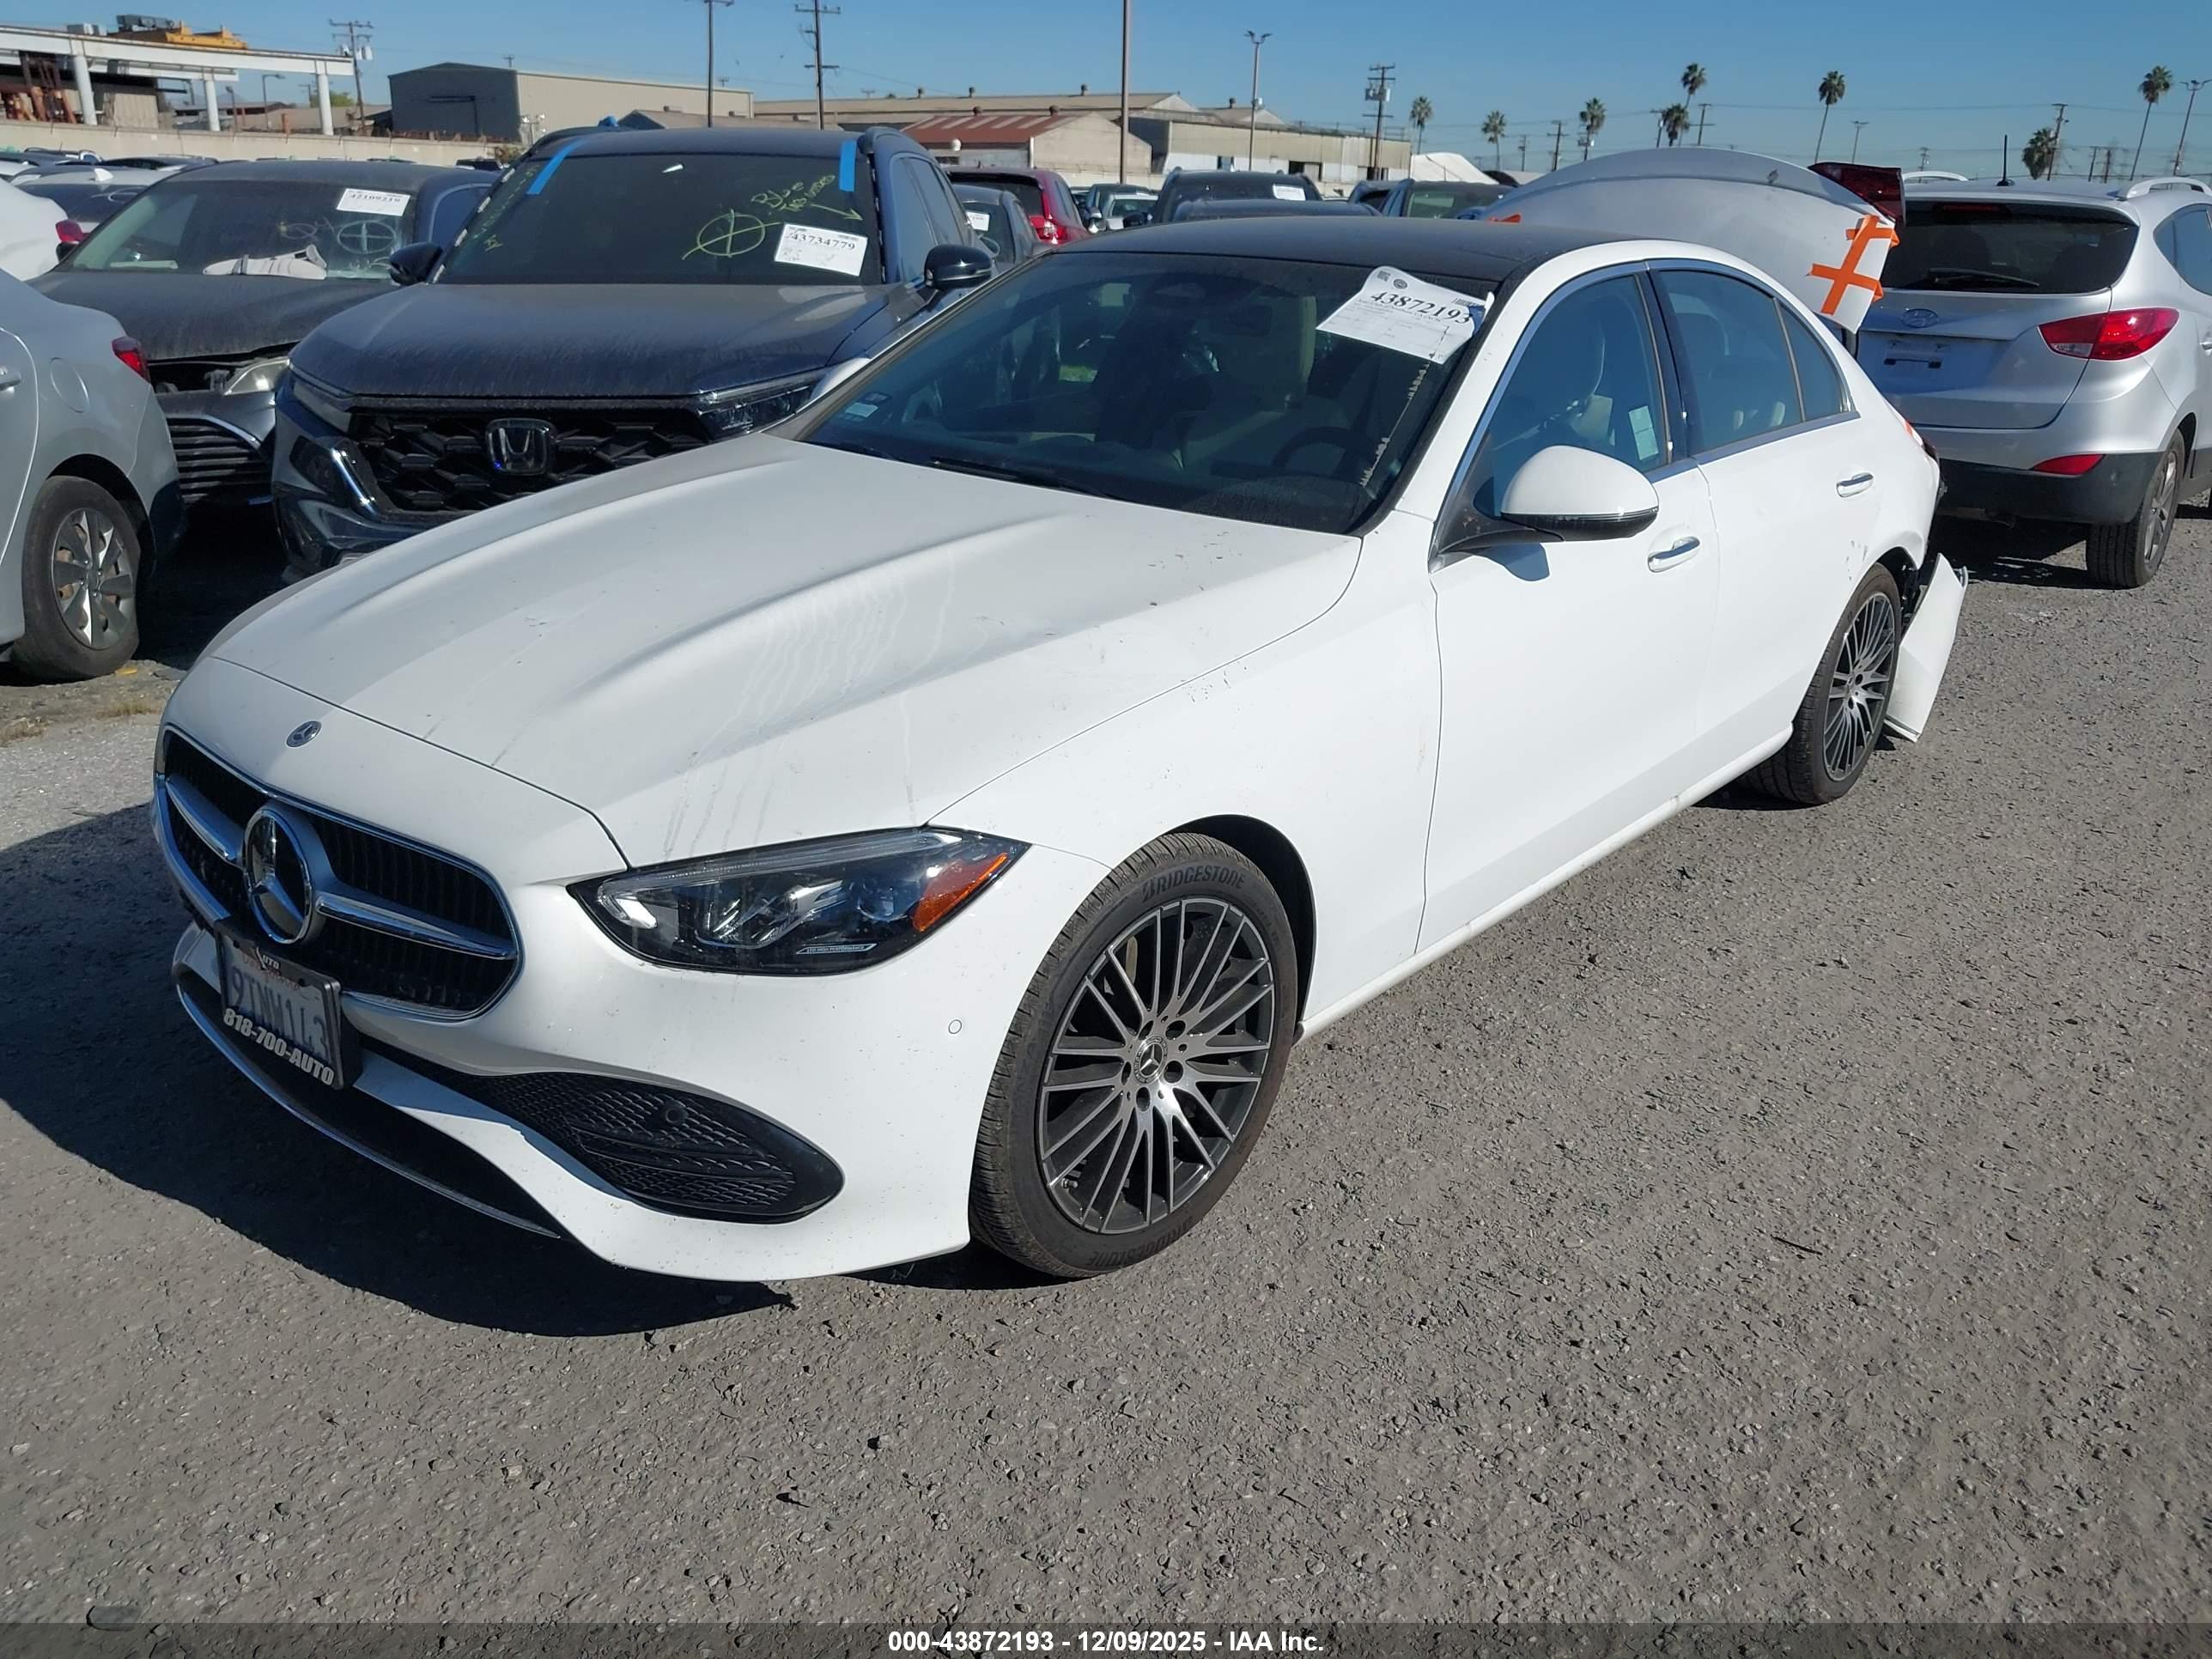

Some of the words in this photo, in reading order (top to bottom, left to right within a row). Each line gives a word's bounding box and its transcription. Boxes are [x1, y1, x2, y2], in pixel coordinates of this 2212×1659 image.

[790, 232, 856, 251] 43734779
[1370, 291, 1473, 325] 43872193
[1142, 865, 1245, 902] BRIDGESTONE
[223, 1007, 335, 1086] 818-700-AUTO
